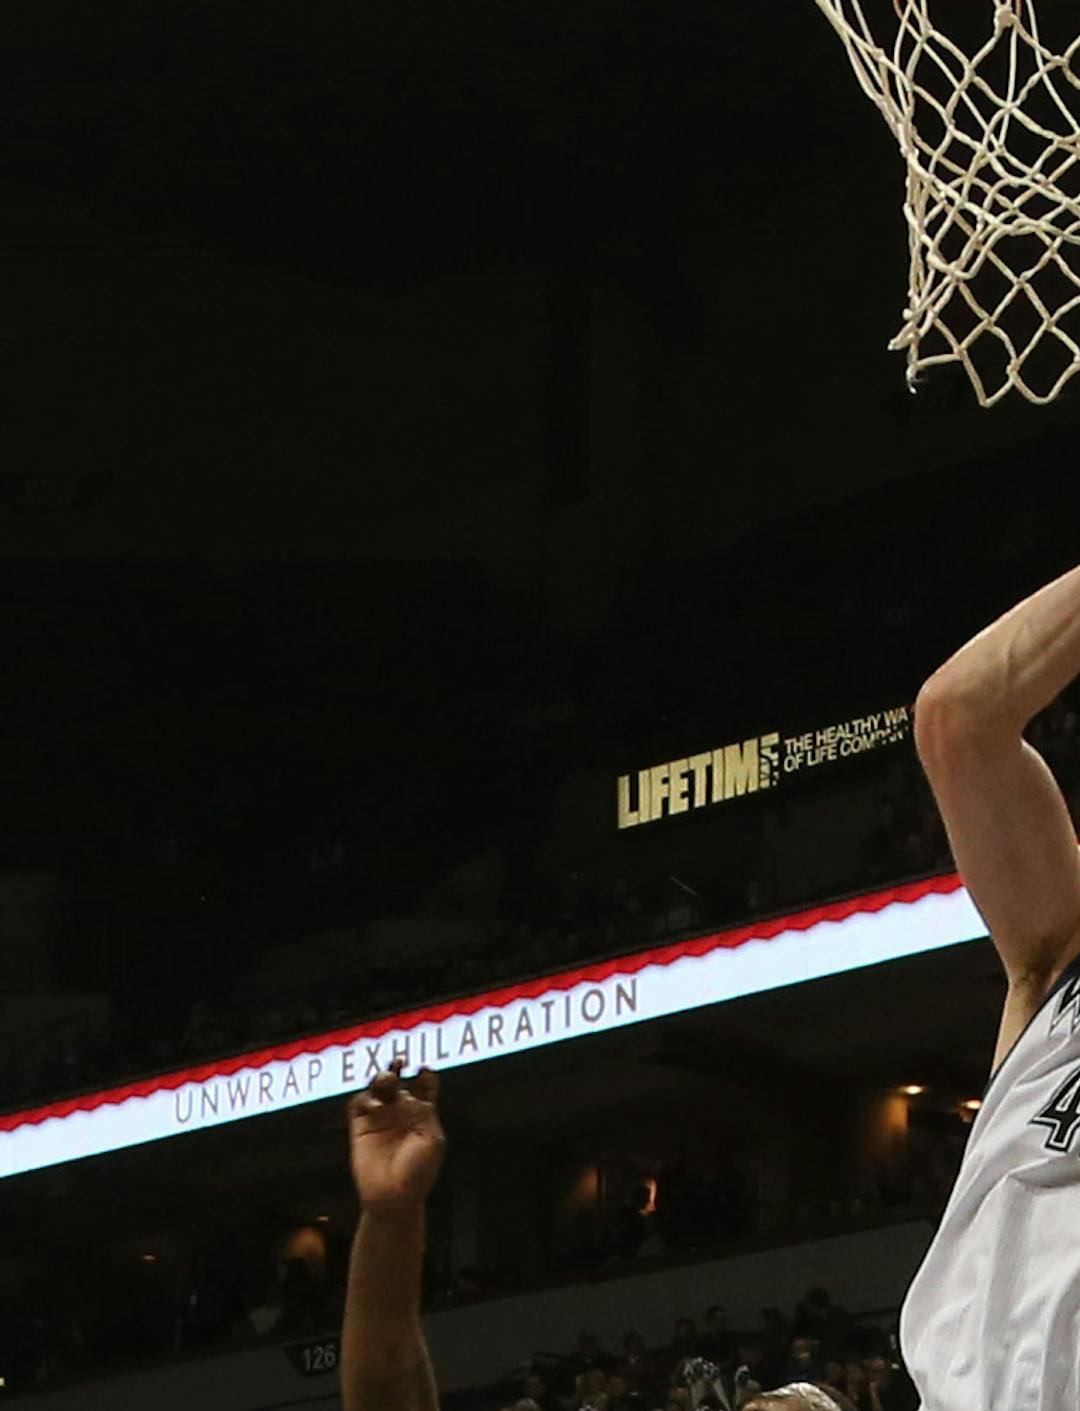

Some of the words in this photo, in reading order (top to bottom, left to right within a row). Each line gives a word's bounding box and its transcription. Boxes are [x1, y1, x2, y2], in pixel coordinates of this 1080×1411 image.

[784, 733, 813, 754] THE
[815, 714, 880, 747] HEALTHY
[882, 706, 909, 727] WA
[784, 753, 803, 772] OF
[806, 743, 837, 767] LIFE
[840, 728, 906, 757] COMP
[175, 1060, 323, 1124] UNWRAP
[342, 977, 639, 1083] EXHILARATION
[302, 1343, 337, 1371] 126
